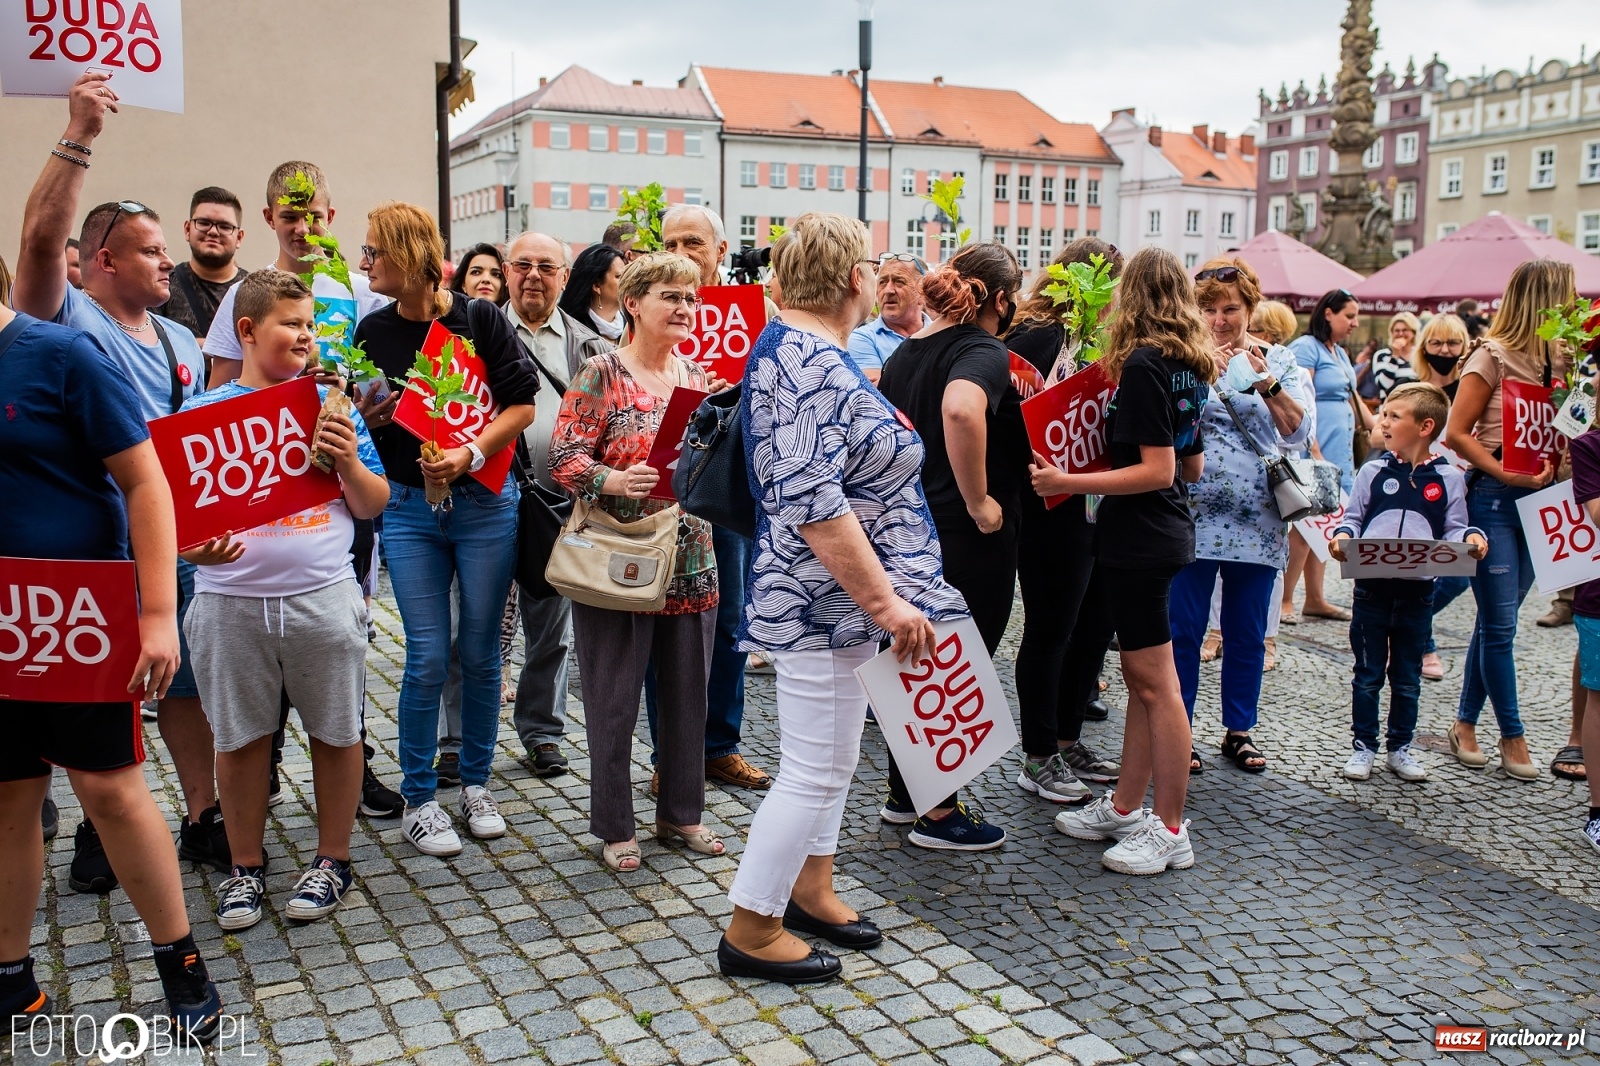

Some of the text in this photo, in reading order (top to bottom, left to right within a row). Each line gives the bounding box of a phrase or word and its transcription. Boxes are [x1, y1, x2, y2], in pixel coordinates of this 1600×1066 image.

[26, 0, 159, 39] DUDA
[29, 24, 162, 73] 2020
[689, 303, 748, 333] DA
[673, 330, 750, 360] 020
[1515, 397, 1556, 429] DUD
[181, 407, 306, 472] DUDA
[1051, 426, 1107, 474] UDA
[1514, 423, 1569, 455] 2020
[190, 440, 312, 509] 2020
[1539, 499, 1586, 536] DU
[1358, 543, 1457, 553] DUDA
[1360, 552, 1458, 566] 2020
[1549, 523, 1597, 563] 20
[0, 584, 108, 626] UDA
[0, 622, 111, 664] 020
[931, 632, 994, 756] DUDA
[898, 658, 967, 772] 2020
